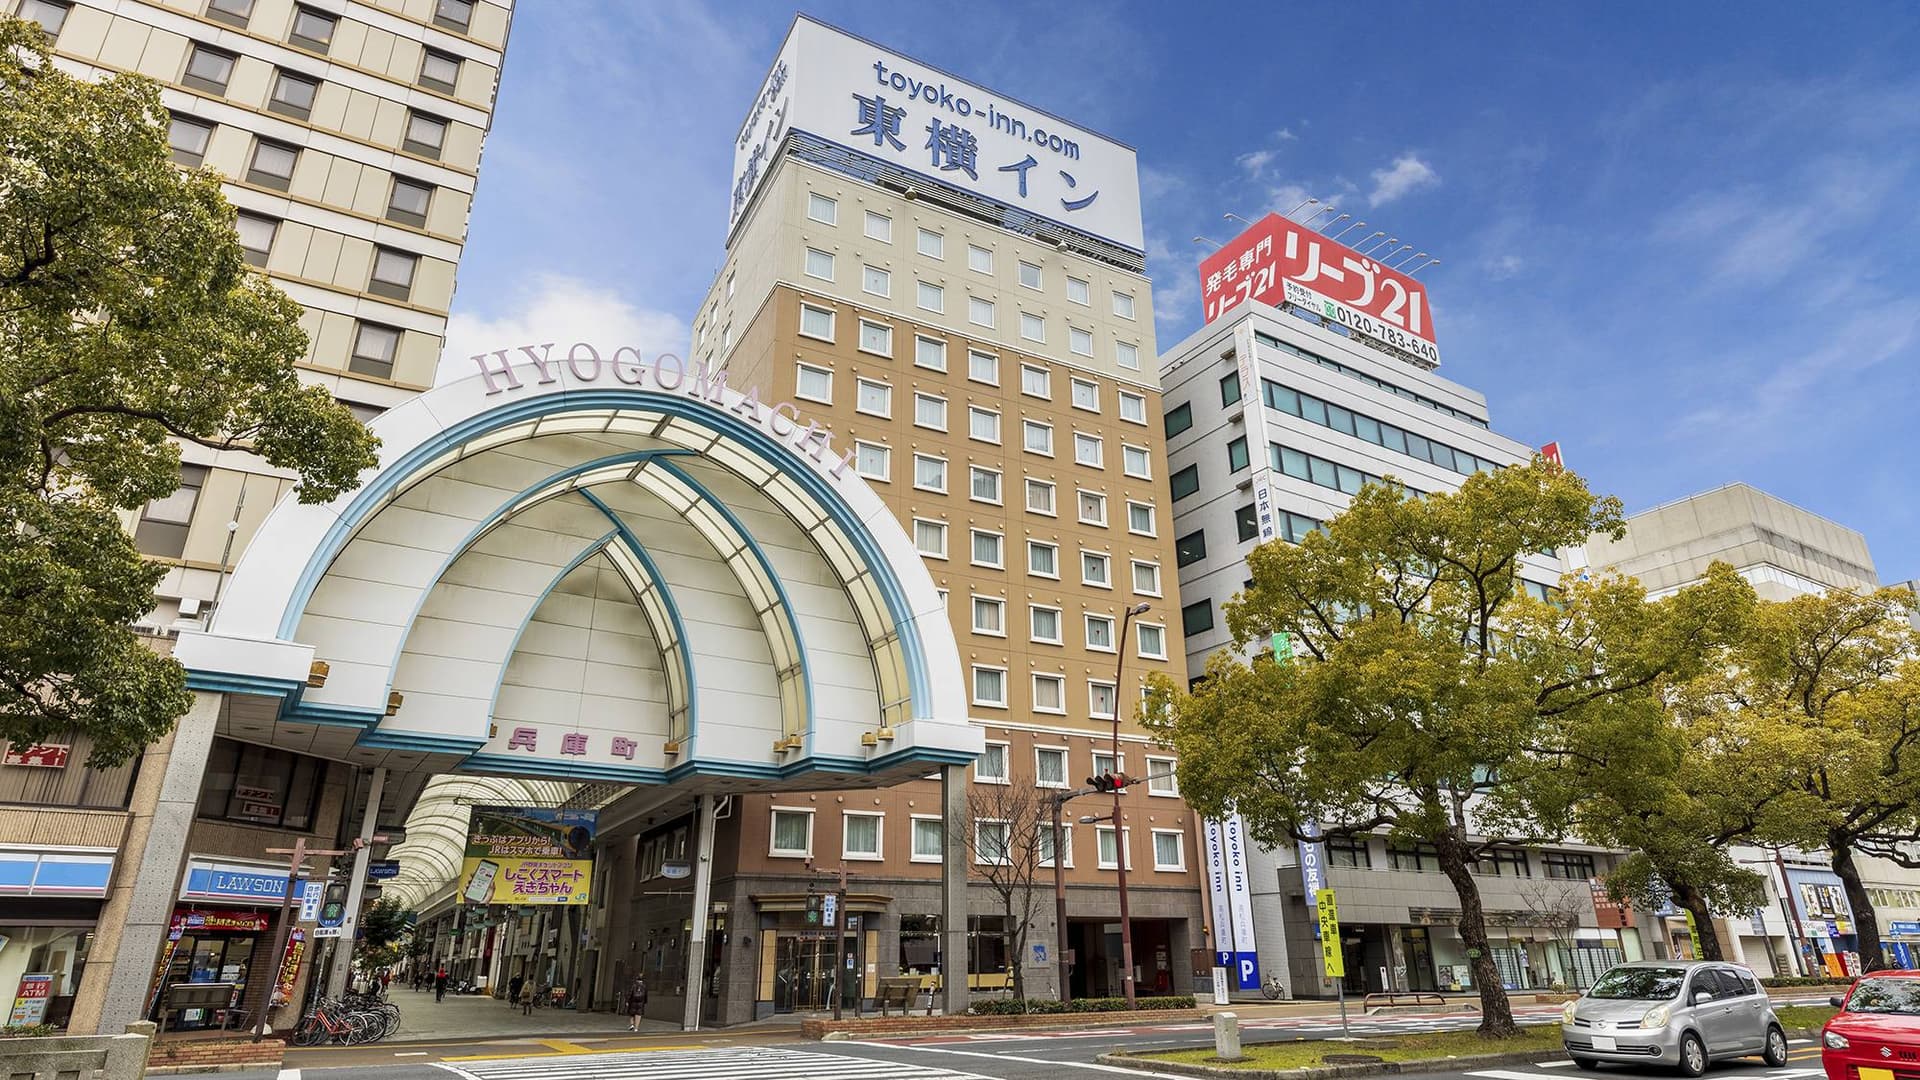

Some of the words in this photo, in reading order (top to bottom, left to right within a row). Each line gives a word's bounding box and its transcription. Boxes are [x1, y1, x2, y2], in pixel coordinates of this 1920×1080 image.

[873, 61, 1080, 161] toyoko-inn.com
[851, 92, 1099, 212] 東横イン
[1206, 234, 1272, 297] 発毛専門
[1285, 230, 1421, 333] リーブ21
[1208, 260, 1276, 320] リーブ21
[1336, 306, 1437, 362] 0120-783-640
[471, 342, 858, 482] HYOGOMACHI
[508, 727, 638, 760] 兵庫町
[1229, 821, 1241, 867] toyoko
[216, 875, 285, 893] LAWSON
[505, 867, 584, 884] しこくスマート
[513, 880, 573, 895] えきちゃん
[1214, 871, 1222, 892] inn
[1234, 871, 1243, 892] inn
[1222, 952, 1229, 965] P
[1241, 959, 1255, 982] P
